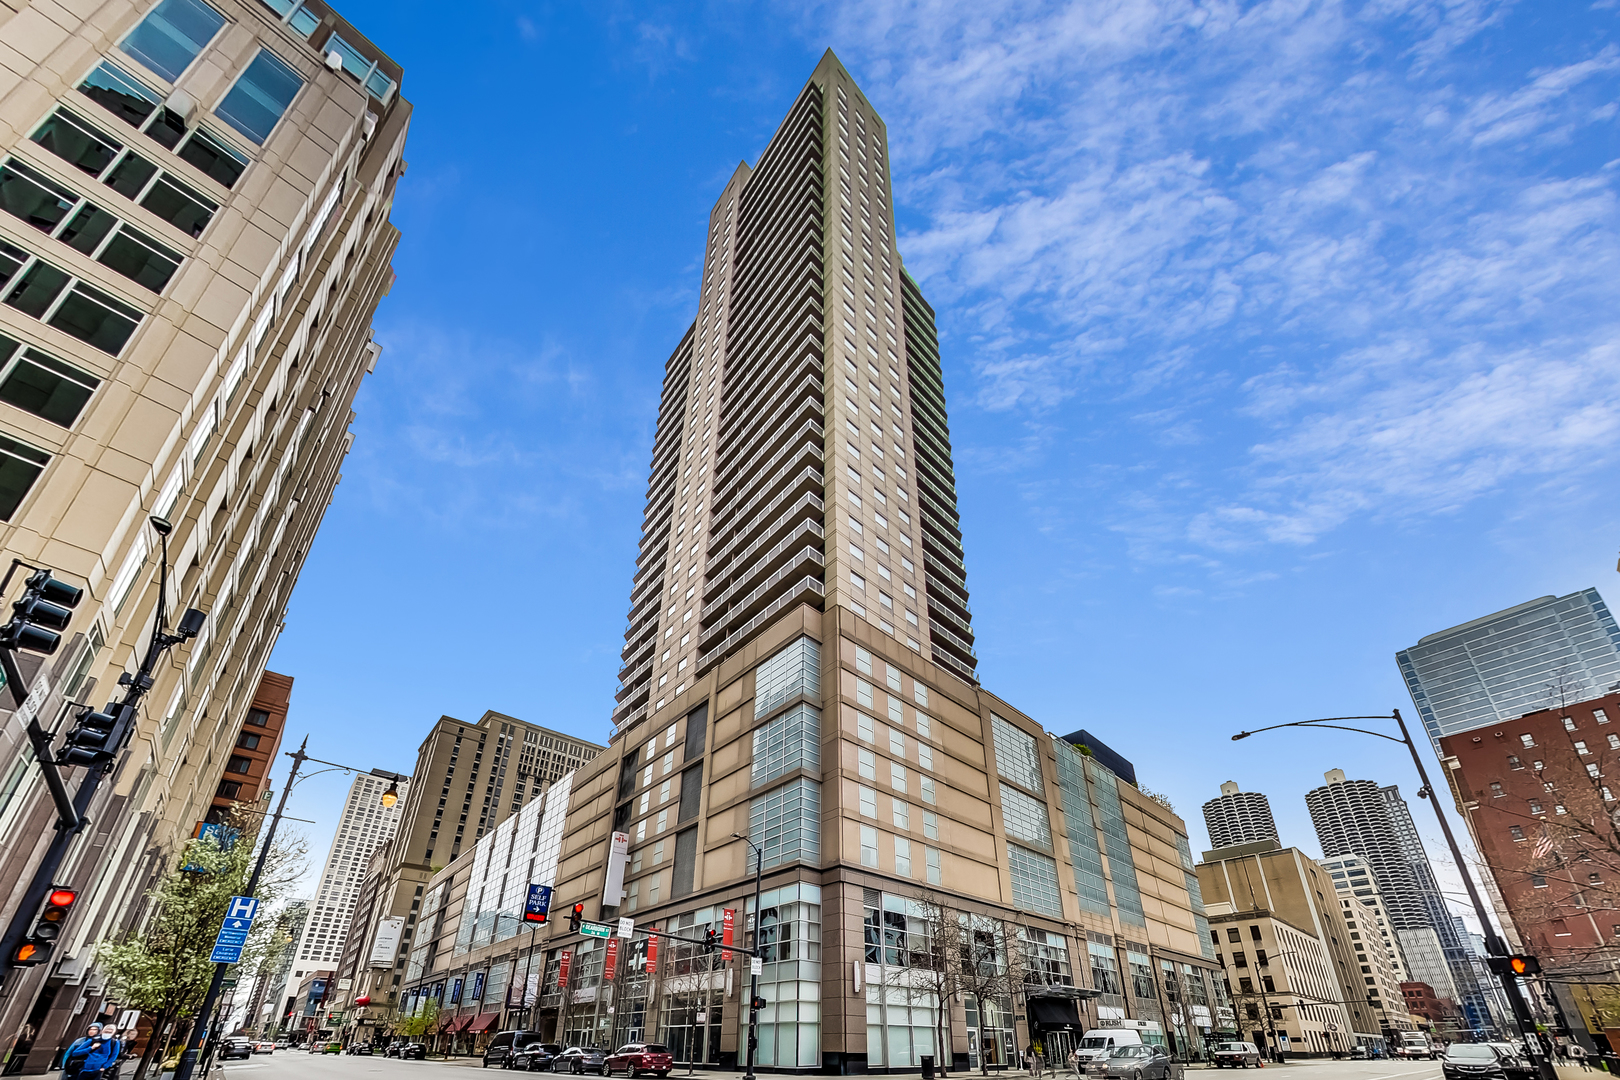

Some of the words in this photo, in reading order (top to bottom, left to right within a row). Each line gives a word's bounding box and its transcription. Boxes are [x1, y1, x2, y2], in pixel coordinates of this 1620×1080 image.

[531, 893, 547, 901] SELF
[529, 899, 547, 907] PARK
[231, 898, 255, 918] H
